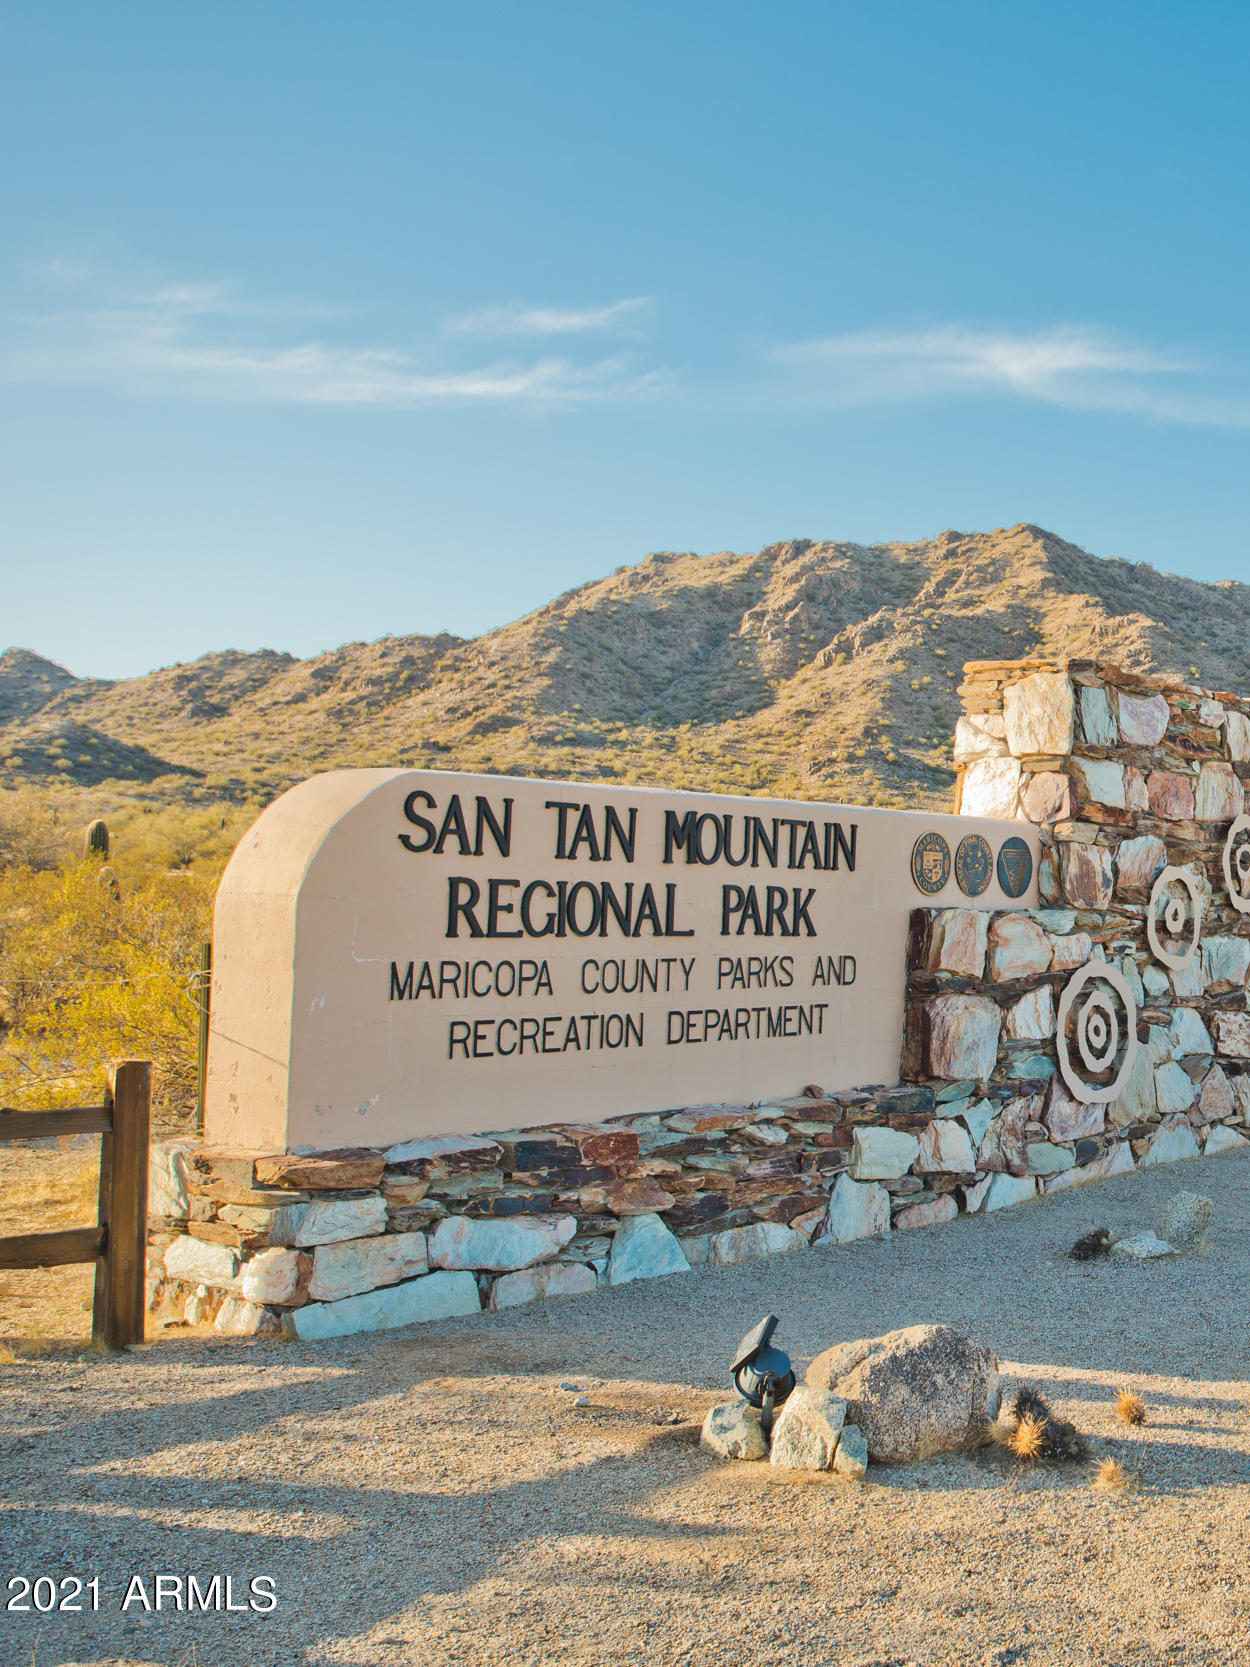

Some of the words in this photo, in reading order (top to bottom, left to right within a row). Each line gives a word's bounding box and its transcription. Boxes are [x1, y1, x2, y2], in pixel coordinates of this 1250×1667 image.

[398, 790, 514, 857] SAN
[545, 801, 638, 863] TAN
[663, 810, 858, 871] MOUNTAIN
[446, 876, 695, 938] REGIONAL
[720, 884, 817, 937] PARK
[919, 877, 946, 892] COUNTY
[390, 960, 553, 1000] MARICOPA
[581, 958, 696, 993] COUNTY
[717, 955, 794, 990] PARKS
[812, 955, 857, 986] AND
[448, 1012, 644, 1059] RECREATION
[667, 1003, 829, 1045] DEPARTMENT
